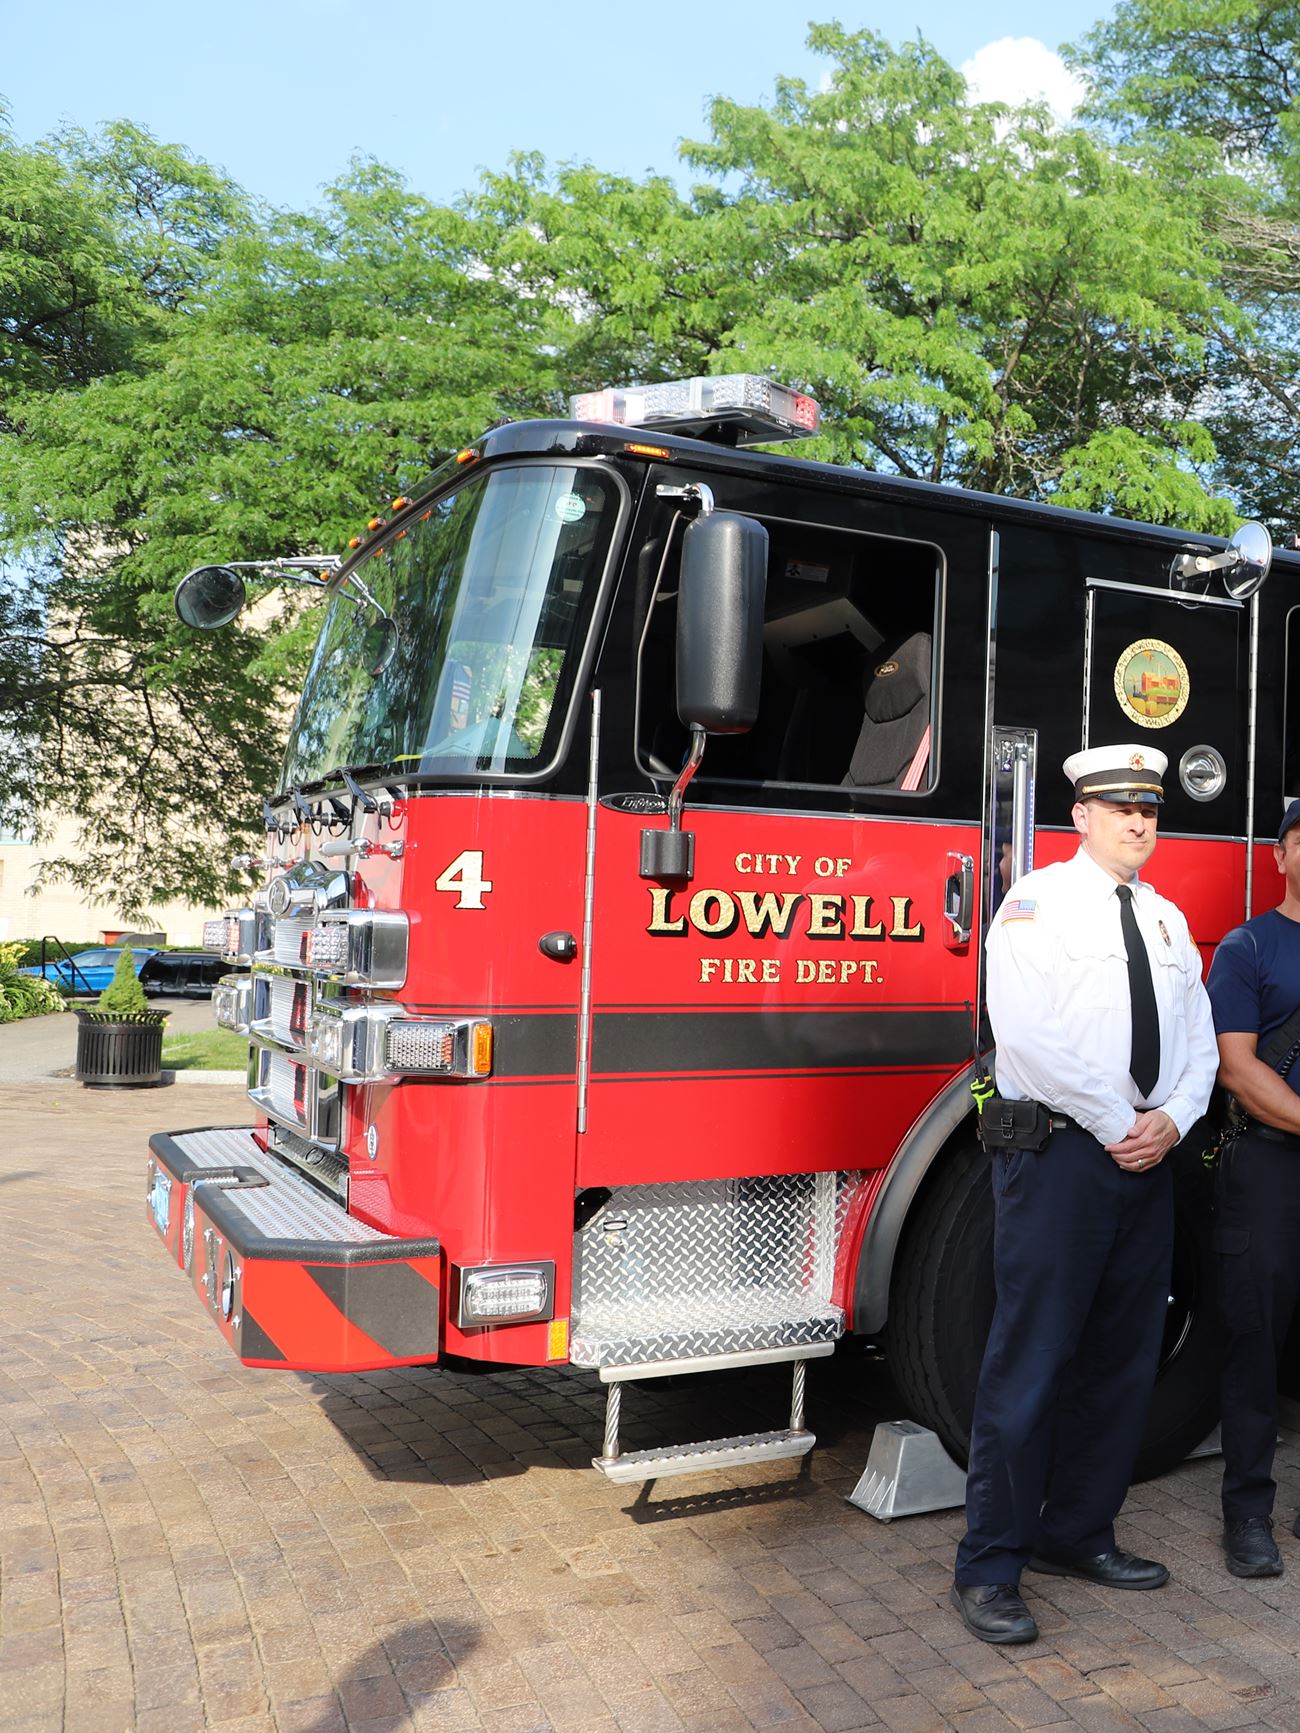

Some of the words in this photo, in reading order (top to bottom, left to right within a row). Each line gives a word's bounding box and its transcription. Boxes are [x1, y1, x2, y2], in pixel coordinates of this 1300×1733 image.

[435, 850, 493, 910] 4
[735, 853, 801, 875] CITY
[814, 857, 851, 877] OF
[646, 888, 924, 942] LOWELL
[699, 958, 781, 983] FIRE
[796, 959, 884, 984] DEPT.
